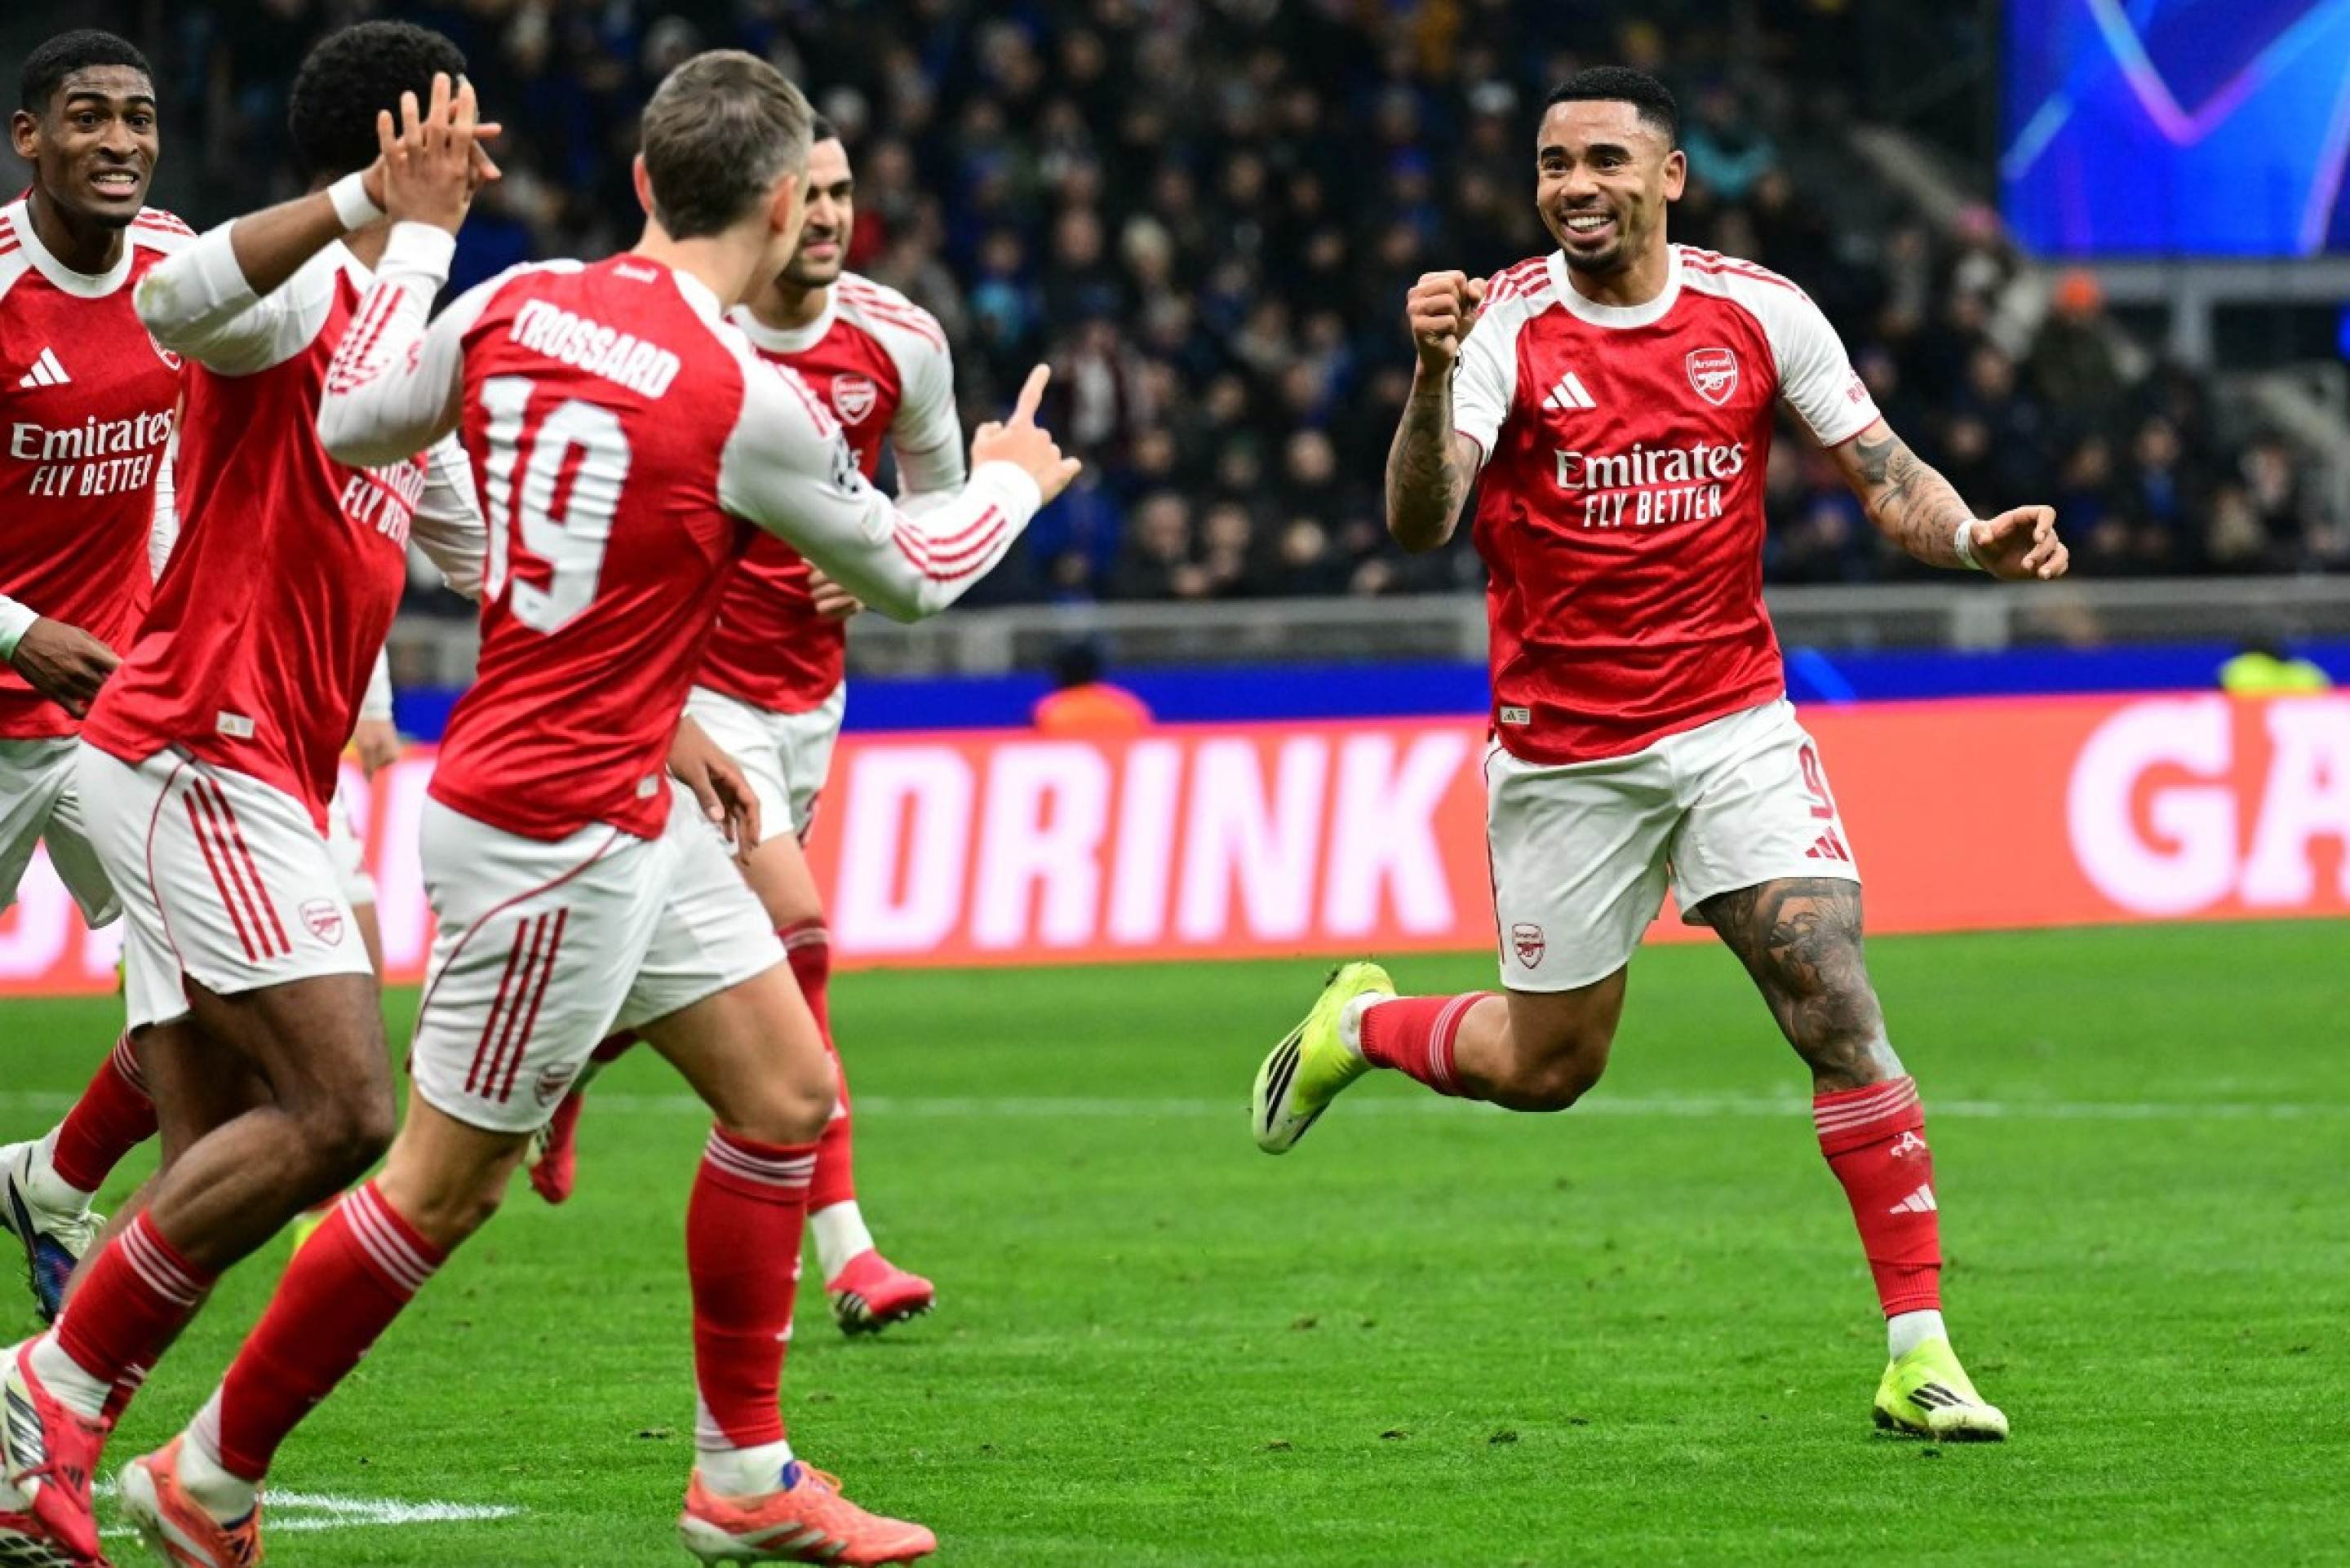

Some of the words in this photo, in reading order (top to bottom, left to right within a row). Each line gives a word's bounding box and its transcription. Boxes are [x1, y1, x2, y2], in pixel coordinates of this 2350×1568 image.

[10, 408, 175, 460] Emirates
[29, 464, 75, 498] FLY
[1554, 440, 1744, 490] Emirates
[339, 474, 384, 525] FLY
[480, 375, 632, 636] 19
[1583, 492, 1629, 528] FLY
[1635, 483, 1723, 526] BETTER
[1798, 742, 1833, 819] 9
[831, 728, 1470, 956] DRINK
